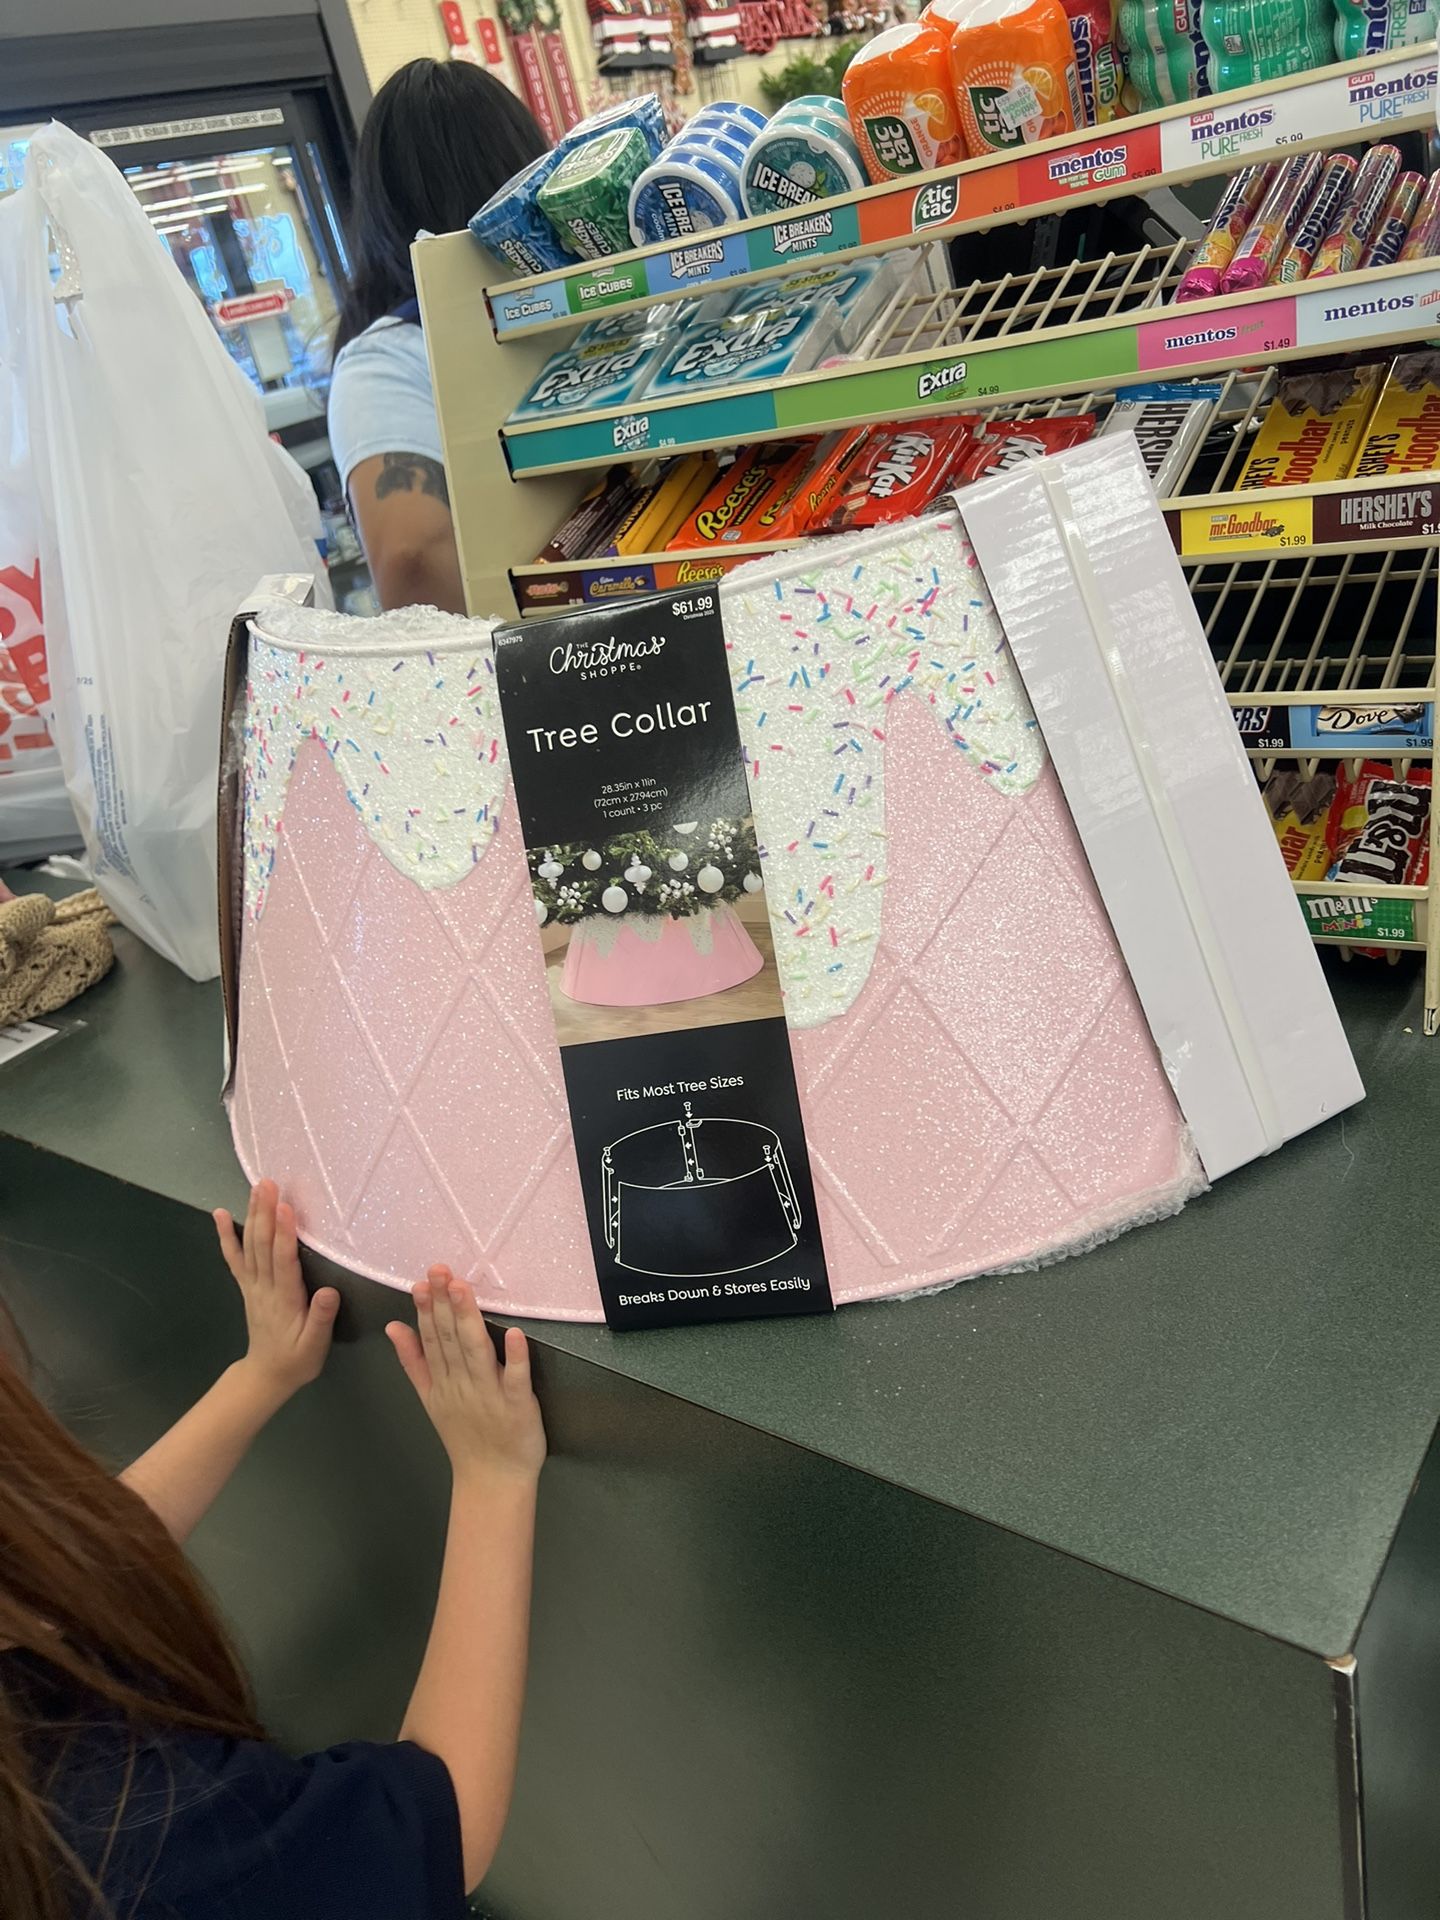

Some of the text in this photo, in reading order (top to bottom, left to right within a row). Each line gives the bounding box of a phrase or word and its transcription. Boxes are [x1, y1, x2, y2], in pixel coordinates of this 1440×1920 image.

[1095, 44, 1116, 104] GUM
[1350, 70, 1437, 103] mentos
[1352, 73, 1373, 84] GUM
[980, 93, 1001, 134] tic
[1193, 112, 1213, 124] GUM
[1360, 89, 1430, 123] PURE FRESH
[910, 116, 934, 158] ORANGE
[1191, 108, 1273, 141] mentos
[874, 124, 897, 162] tic
[887, 123, 915, 168] tac
[1202, 128, 1263, 160] PURE FRESH
[1050, 147, 1126, 178] mentos
[1094, 164, 1126, 181] GUM
[753, 162, 780, 192] ICE
[659, 183, 685, 207] ICE
[928, 185, 952, 202] tic
[921, 201, 952, 219] tac
[585, 221, 612, 254] CUBES
[773, 212, 832, 244] ICE BREAKERS
[513, 241, 542, 273] CUBES
[671, 240, 724, 271] ICE BREAKERS
[792, 237, 817, 253] MINTS
[688, 263, 711, 278] MINTS
[1325, 294, 1415, 321] mentos
[670, 317, 801, 377] Extra
[1166, 326, 1237, 349] mentos
[1264, 337, 1290, 351] $1.49
[529, 350, 646, 402] Extra
[918, 361, 967, 399] Extra
[977, 385, 999, 397] $4.99
[613, 416, 649, 447] Extra
[697, 465, 769, 540] Reese's
[1341, 490, 1432, 525] HERSHEY'S
[1377, 520, 1414, 529] Chocolate
[1280, 535, 1306, 547] $1.99
[677, 560, 724, 583] Reese's
[672, 596, 713, 616] $61.99
[550, 636, 666, 674] Christmas
[580, 662, 635, 681] SHOPPE
[527, 701, 711, 752] Tree Collar
[1322, 707, 1397, 730] Dove
[1258, 738, 1284, 748] $1.99
[1406, 738, 1433, 748] $1.99
[594, 797, 621, 809] (72cm
[630, 787, 669, 803] 27.94cm)
[601, 781, 634, 795] 28.35in
[641, 778, 656, 787] 11in
[603, 802, 663, 818] 1 count 3 pc
[1377, 928, 1405, 938] $1.99
[616, 1075, 744, 1102] Fits Most Tree Sizes
[618, 1276, 811, 1306] Breaks Down & Stores Easily
